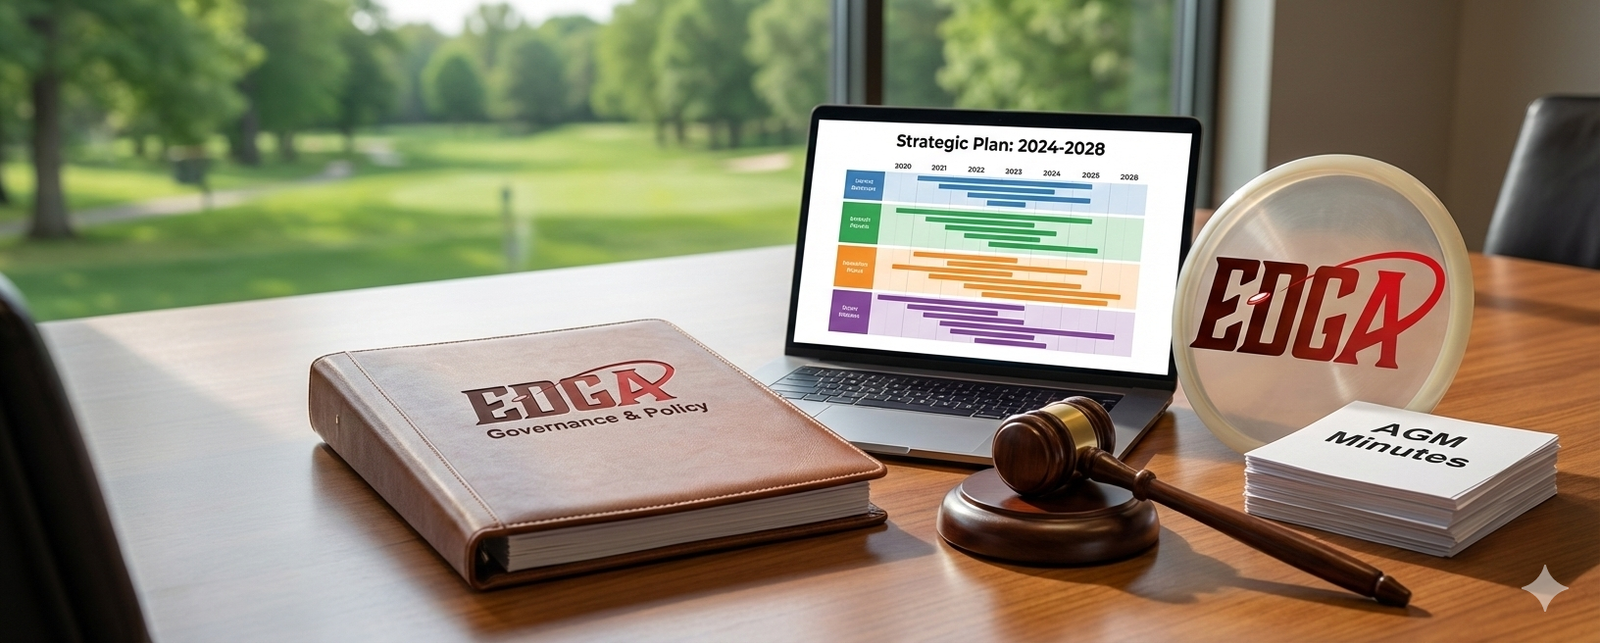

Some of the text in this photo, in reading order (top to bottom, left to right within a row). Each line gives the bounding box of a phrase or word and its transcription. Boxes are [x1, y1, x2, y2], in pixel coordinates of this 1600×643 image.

[896, 134, 1106, 156] Strategic Plan: 2024-2028
[894, 162, 912, 170] 2020
[967, 166, 985, 174] 2022
[1043, 169, 1061, 177] 2024
[1120, 173, 1139, 181] 2028
[1189, 252, 1445, 370] EDGA
[461, 360, 678, 426] EDGA
[486, 401, 709, 440] Governance & Policy
[1371, 423, 1468, 448] AGM
[1325, 430, 1470, 468] Minutes
